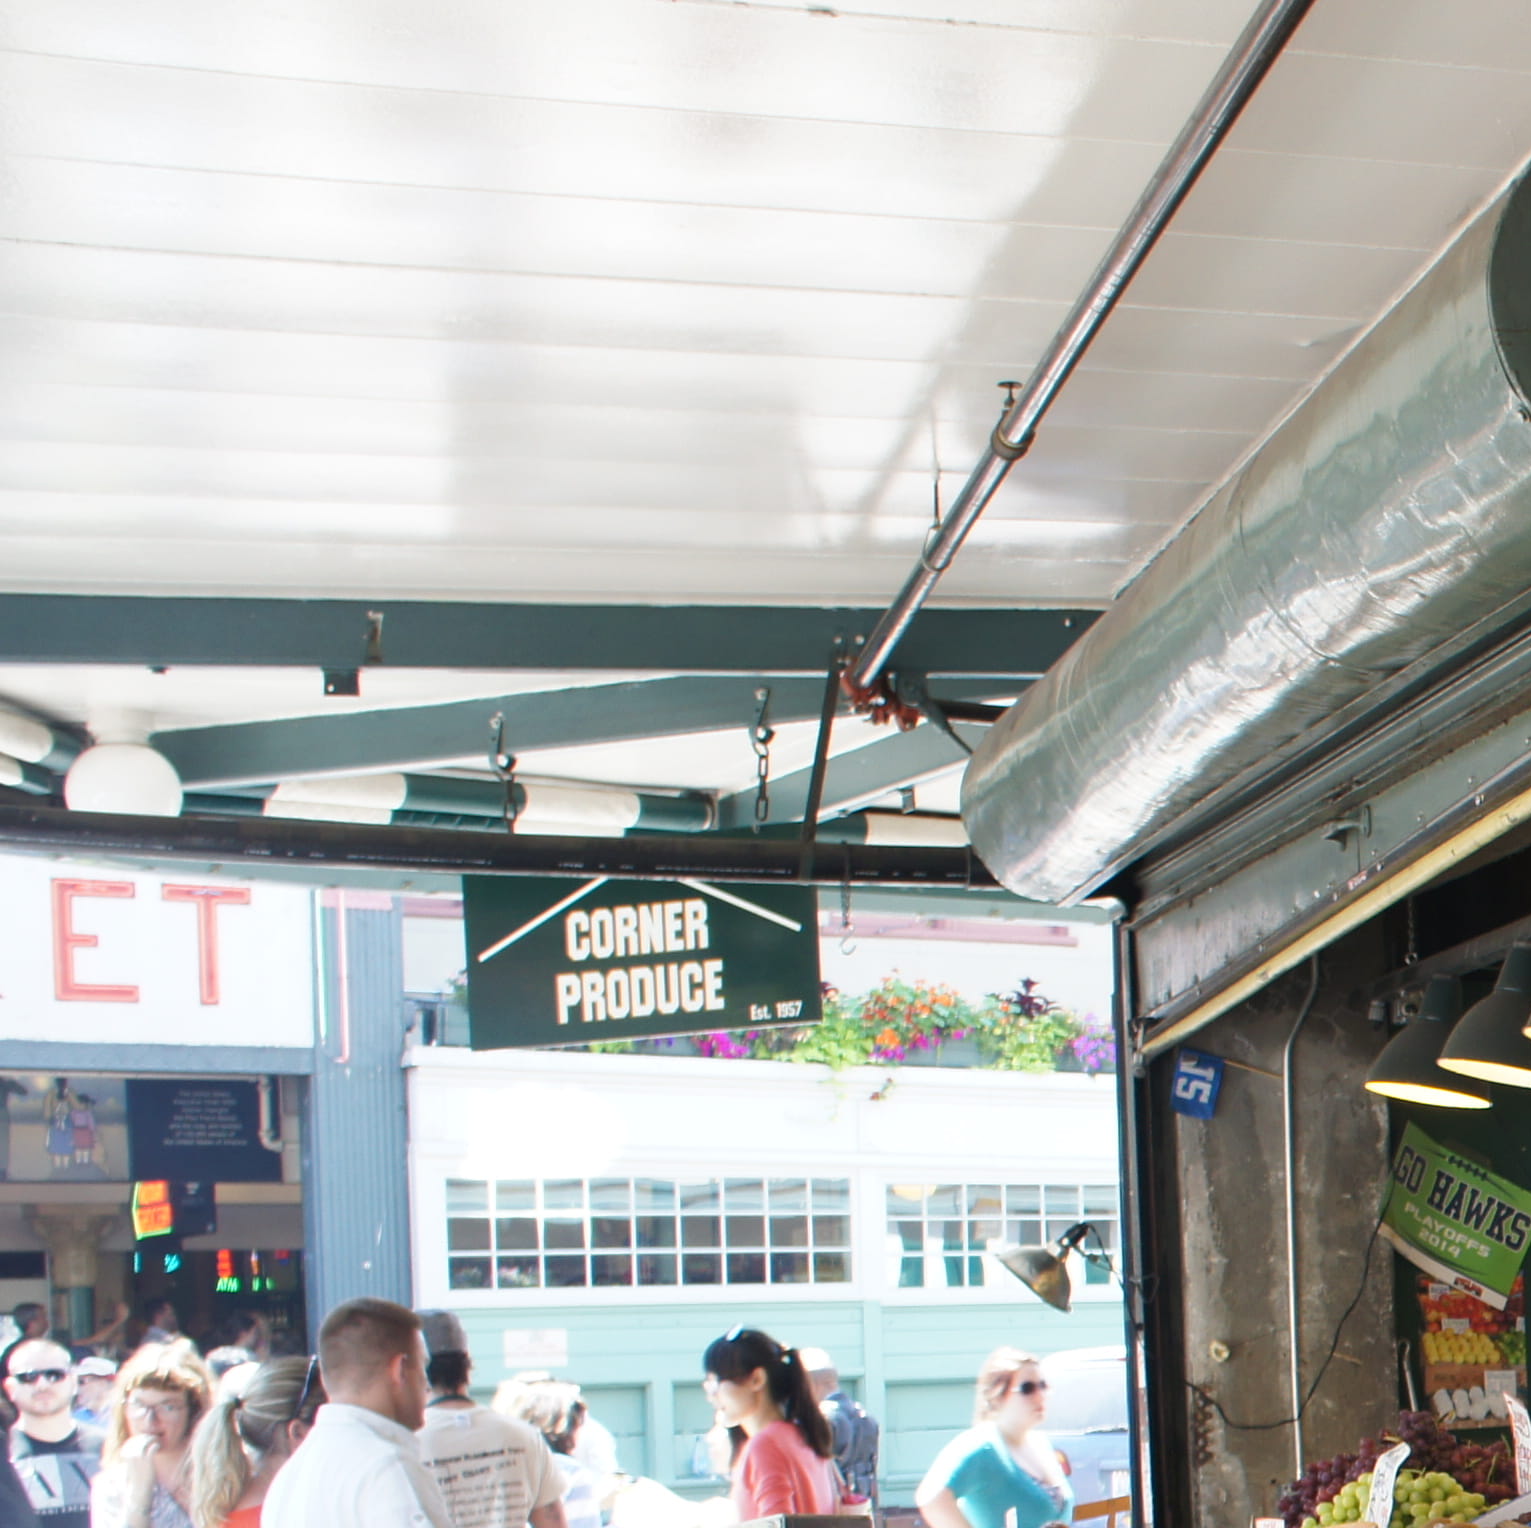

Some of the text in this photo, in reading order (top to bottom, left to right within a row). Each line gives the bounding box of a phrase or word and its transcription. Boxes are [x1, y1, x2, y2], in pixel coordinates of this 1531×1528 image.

[565, 898, 710, 962] CORNER
[555, 959, 726, 1025] PRODUCE
[750, 1000, 803, 1021] Est. 1957
[1394, 1145, 1427, 1194] GO
[1404, 1201, 1491, 1258] PLAYOFFS
[1418, 1227, 1463, 1259] 2014
